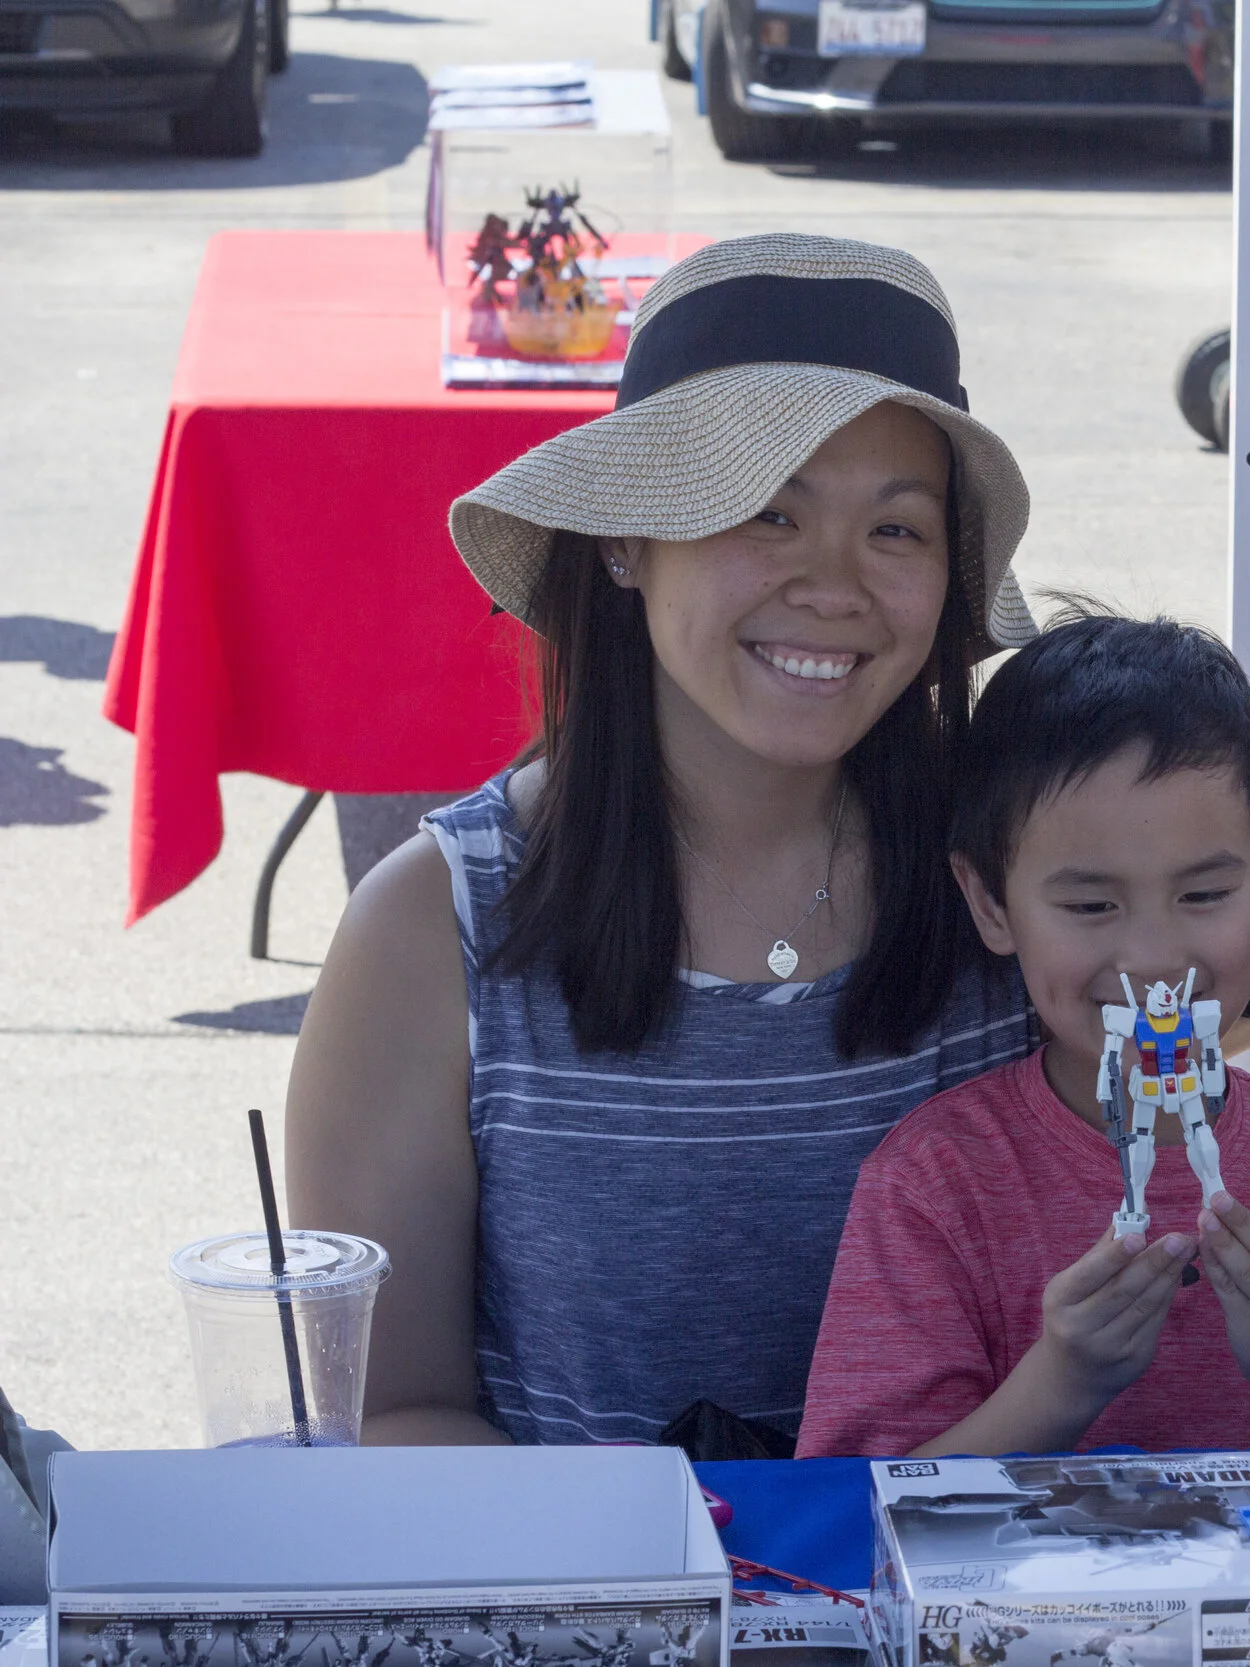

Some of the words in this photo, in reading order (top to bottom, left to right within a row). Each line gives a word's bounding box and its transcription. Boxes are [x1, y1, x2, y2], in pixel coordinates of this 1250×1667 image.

[898, 1464, 933, 1472] DAI
[892, 1470, 933, 1478] BAN
[918, 1604, 963, 1629] HG
[795, 1620, 852, 1629] 1/144
[733, 1628, 808, 1644] RX-7
